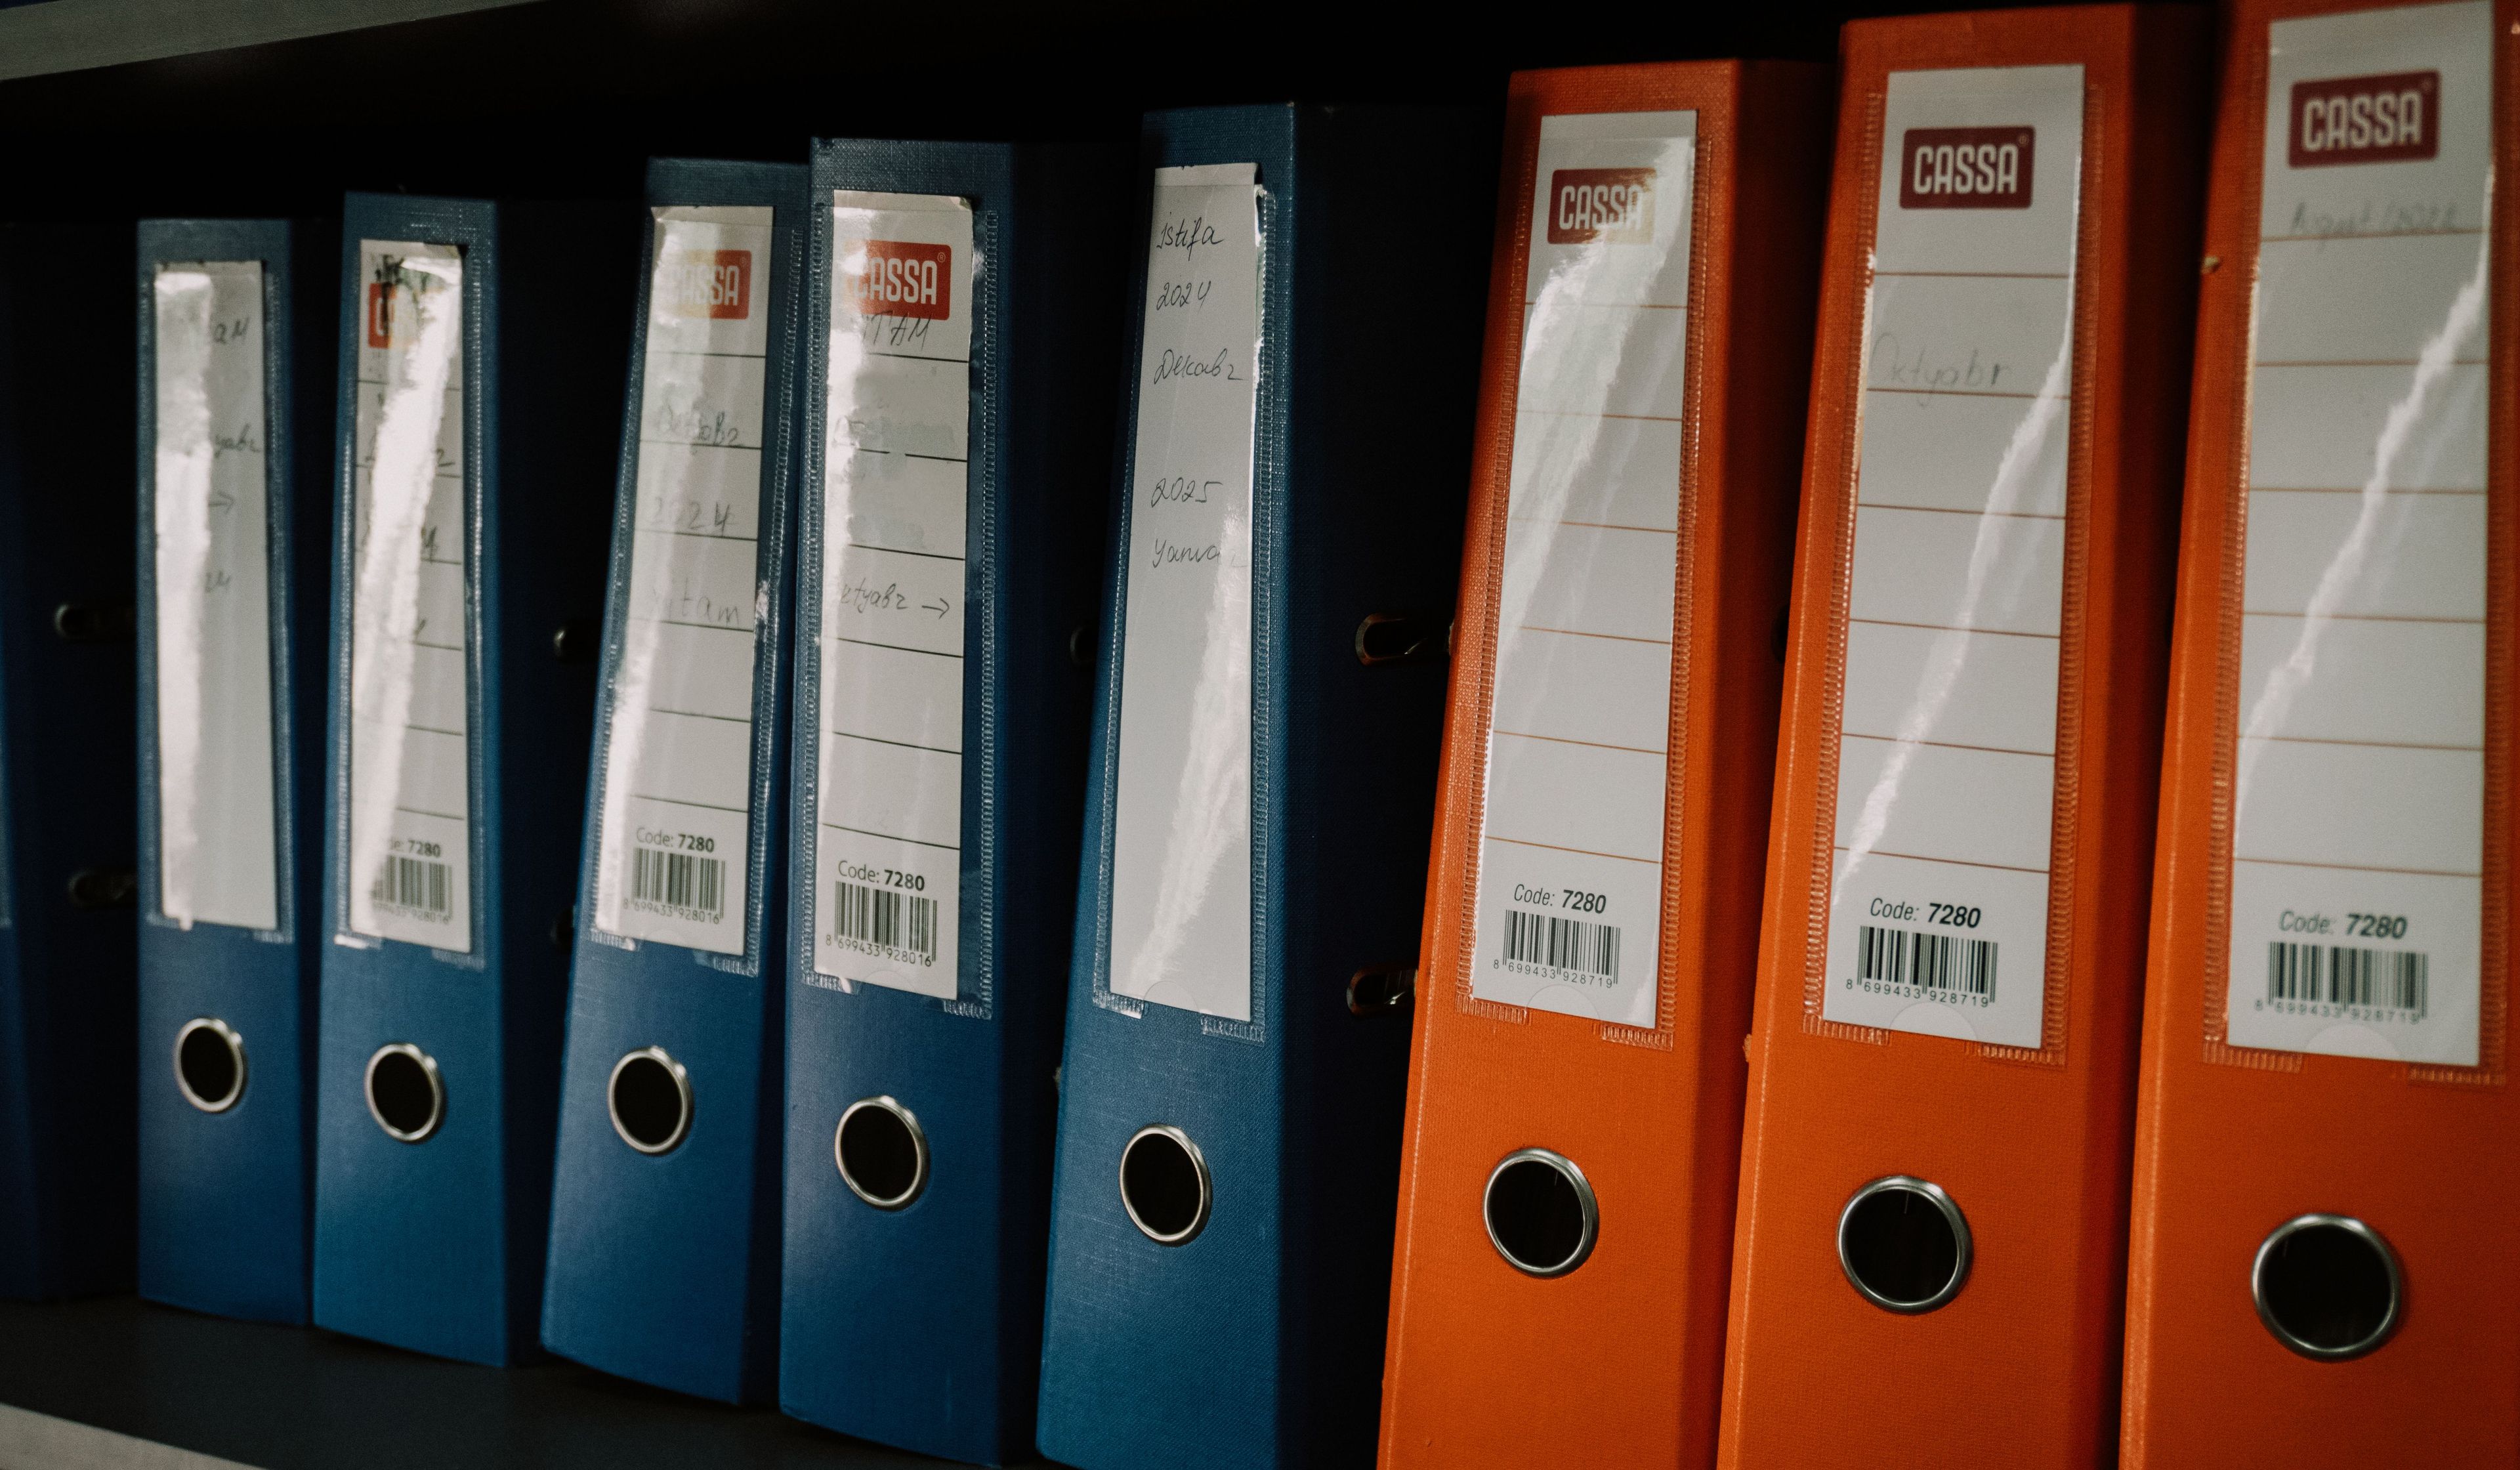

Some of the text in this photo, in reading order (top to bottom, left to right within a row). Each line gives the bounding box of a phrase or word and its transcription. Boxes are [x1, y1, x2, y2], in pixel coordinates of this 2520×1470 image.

[2301, 89, 2423, 152] CASSA
[1913, 144, 2019, 195] CASSA
[1559, 184, 1643, 230] CASSA
[1156, 281, 1211, 311] 2024
[1152, 477, 1223, 508] 2025
[408, 839, 442, 858] 7280
[636, 827, 715, 853] Code: 7280
[838, 860, 925, 891] Code: 7280
[1514, 884, 1606, 914] Code: 7280
[1870, 898, 1981, 929] Code: 7280
[679, 908, 720, 925] 928016
[2345, 912, 2408, 940] 7280
[826, 934, 932, 967] 8 699433 928016
[1493, 959, 1612, 988] 8 699433 928719
[1845, 978, 1988, 1008] 8 699433 928719
